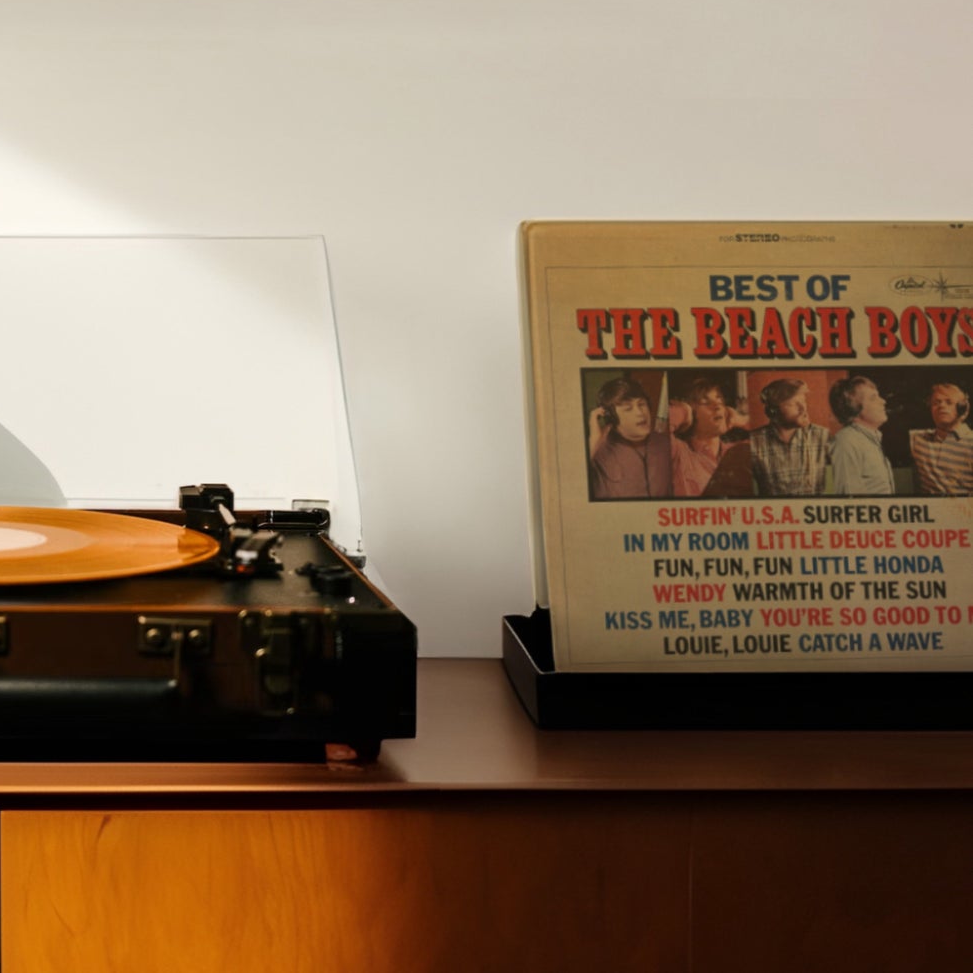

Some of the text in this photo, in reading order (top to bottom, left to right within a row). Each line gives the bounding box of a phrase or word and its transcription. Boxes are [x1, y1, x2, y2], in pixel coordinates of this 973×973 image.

[735, 233, 780, 243] STEREO
[709, 274, 851, 302] BEST OF
[576, 308, 682, 360] THE
[690, 306, 857, 358] BEACH
[658, 504, 935, 527] SURFIN' U.S.A. SURFER GIRL
[623, 529, 971, 552] IN MY ROOM LITTLE DEUCE COUPE
[654, 555, 944, 580] FUN, FUN, FUN LITTLE HONDA
[652, 580, 947, 603] WENDY WARMTH OF THE SUN
[604, 611, 653, 630] KISS
[658, 610, 696, 632] ME,
[699, 609, 753, 628] BABY
[760, 607, 834, 627] YOU'RE
[840, 606, 866, 626] SO
[873, 606, 930, 626] GOOD
[934, 605, 961, 625] TO
[664, 631, 944, 657] LOUIE, LOUIE CATCH A WAVE
